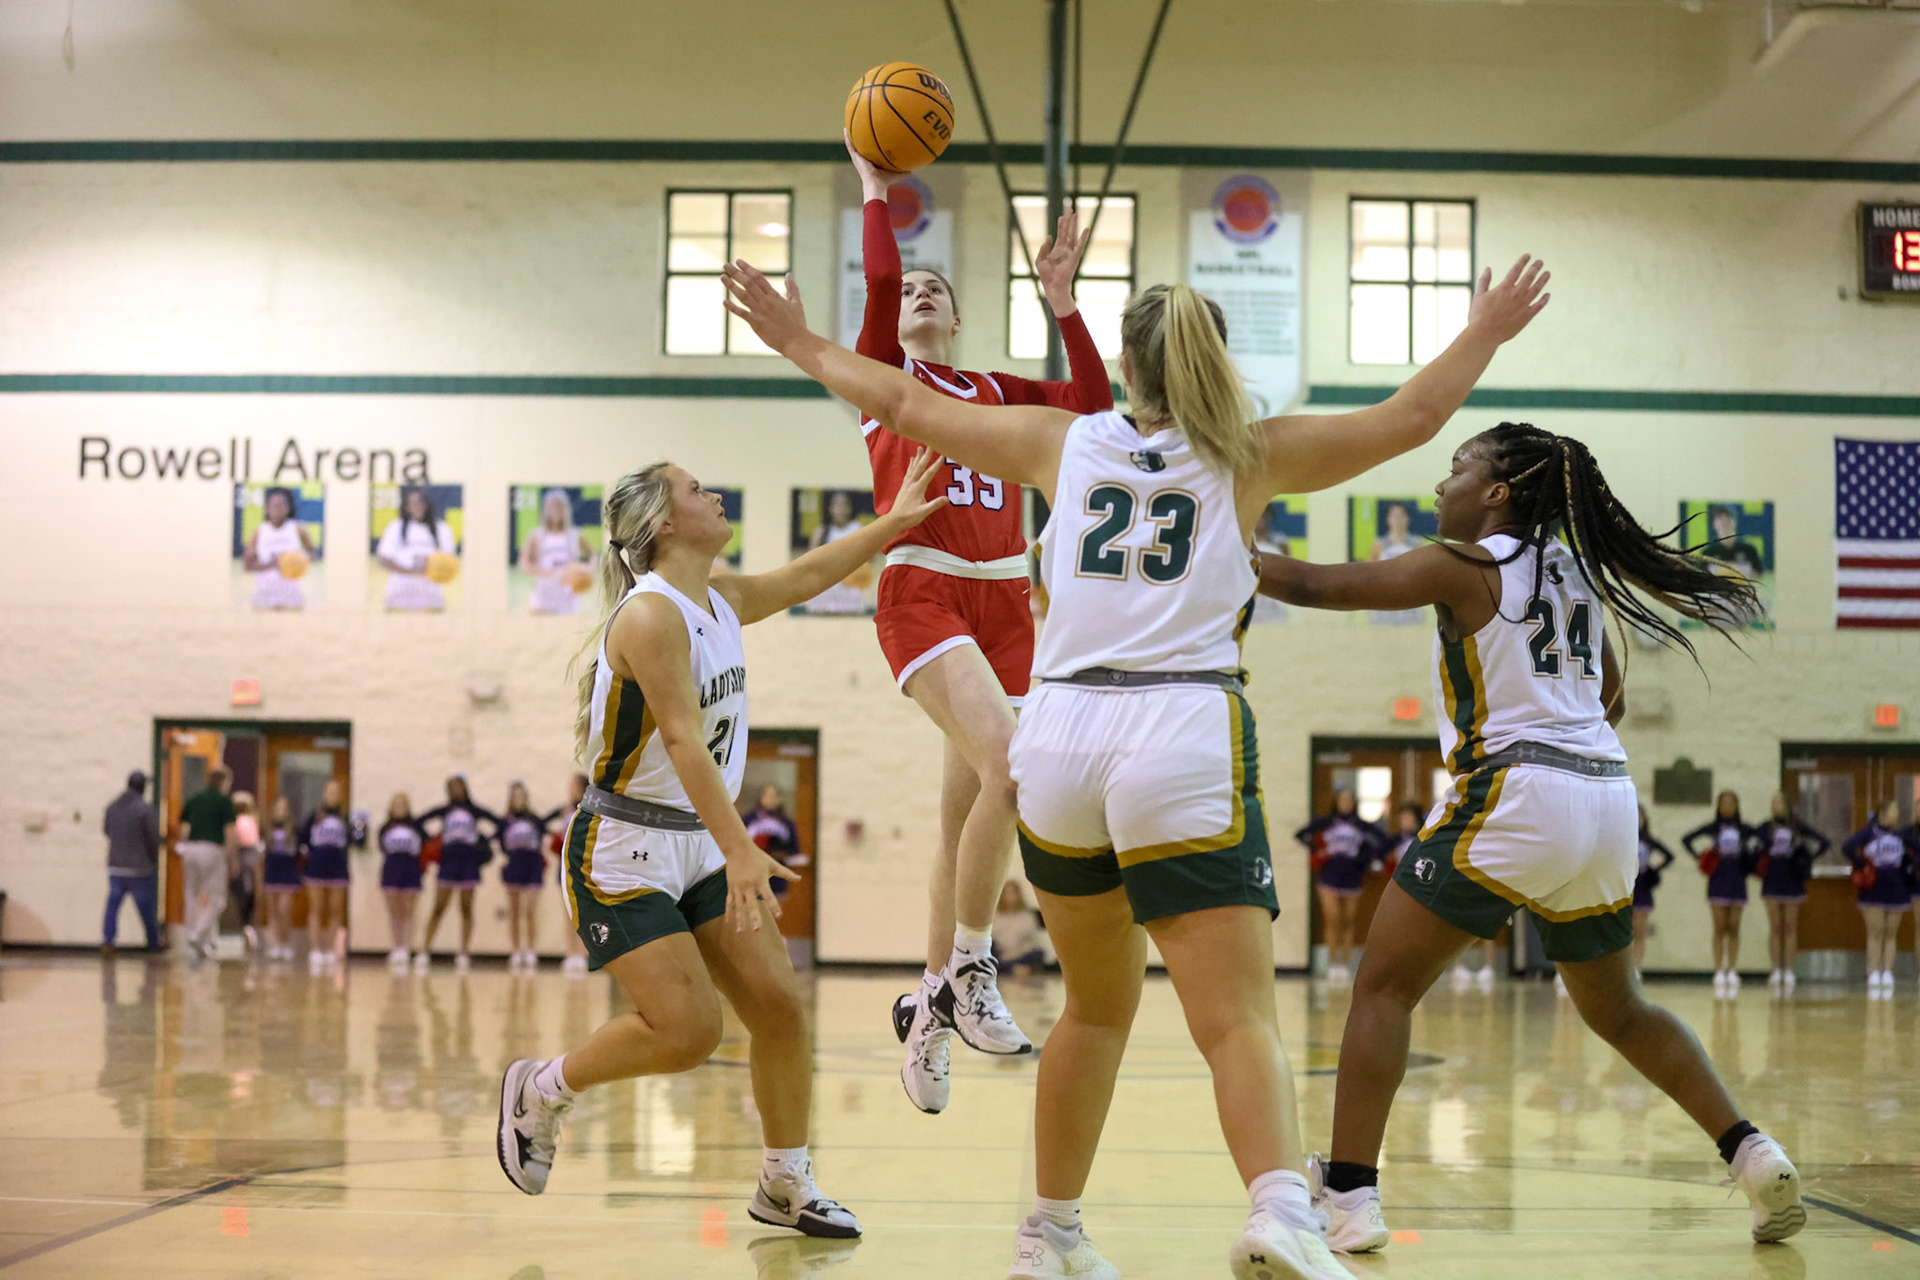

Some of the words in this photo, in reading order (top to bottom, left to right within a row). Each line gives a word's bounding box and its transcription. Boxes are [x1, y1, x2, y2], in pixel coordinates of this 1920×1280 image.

[1873, 208, 1920, 228] HOME
[1893, 231, 1920, 272] 13
[79, 436, 251, 481] Rowell
[272, 437, 430, 484] Arena
[1074, 481, 1202, 586] 23
[1524, 595, 1597, 680] 24
[706, 712, 739, 769] 21
